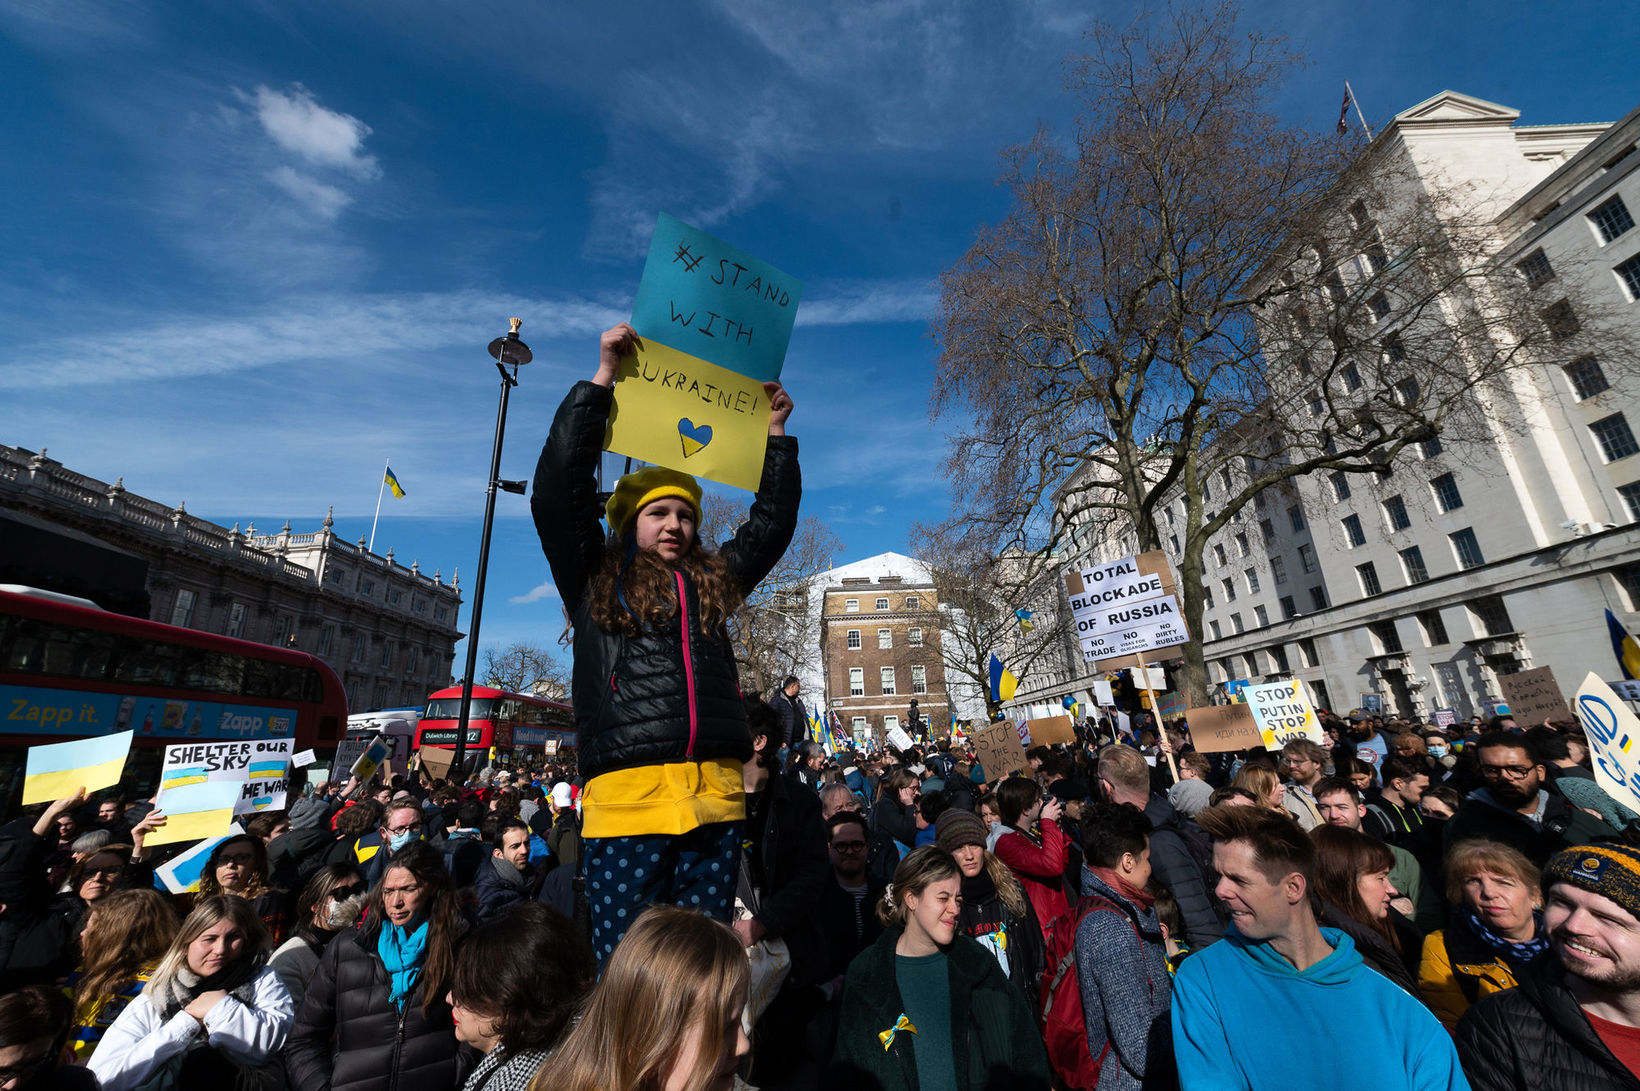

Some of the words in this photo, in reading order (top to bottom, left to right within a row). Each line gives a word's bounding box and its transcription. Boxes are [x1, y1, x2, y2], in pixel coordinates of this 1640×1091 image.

[670, 300, 754, 346] WITH
[642, 361, 758, 416] UKRAINE!
[1083, 563, 1136, 584] TOTAL
[1072, 579, 1161, 611] BLOCKADE
[1078, 619, 1097, 632] OF
[1108, 602, 1173, 625] RUSSIA
[1091, 639, 1105, 647] NO
[1123, 631, 1138, 640] NO
[1155, 629, 1178, 638] DIRTY
[1155, 635, 1185, 645] RUBLES
[1085, 646, 1116, 658] TRADE
[1255, 687, 1295, 703] STOP
[8, 699, 73, 728] Zapp
[79, 703, 100, 724] it.
[1259, 703, 1304, 718] PUTIN
[220, 712, 263, 736] Zapp
[1267, 716, 1306, 731] STOP
[978, 722, 1012, 750] STOP
[168, 743, 251, 765] SHELTER
[256, 742, 288, 753] OUR
[991, 746, 1009, 759] THE
[203, 755, 252, 772] SKY
[987, 752, 1022, 776] WAR
[242, 783, 263, 800] HE
[263, 780, 288, 795] WAR
